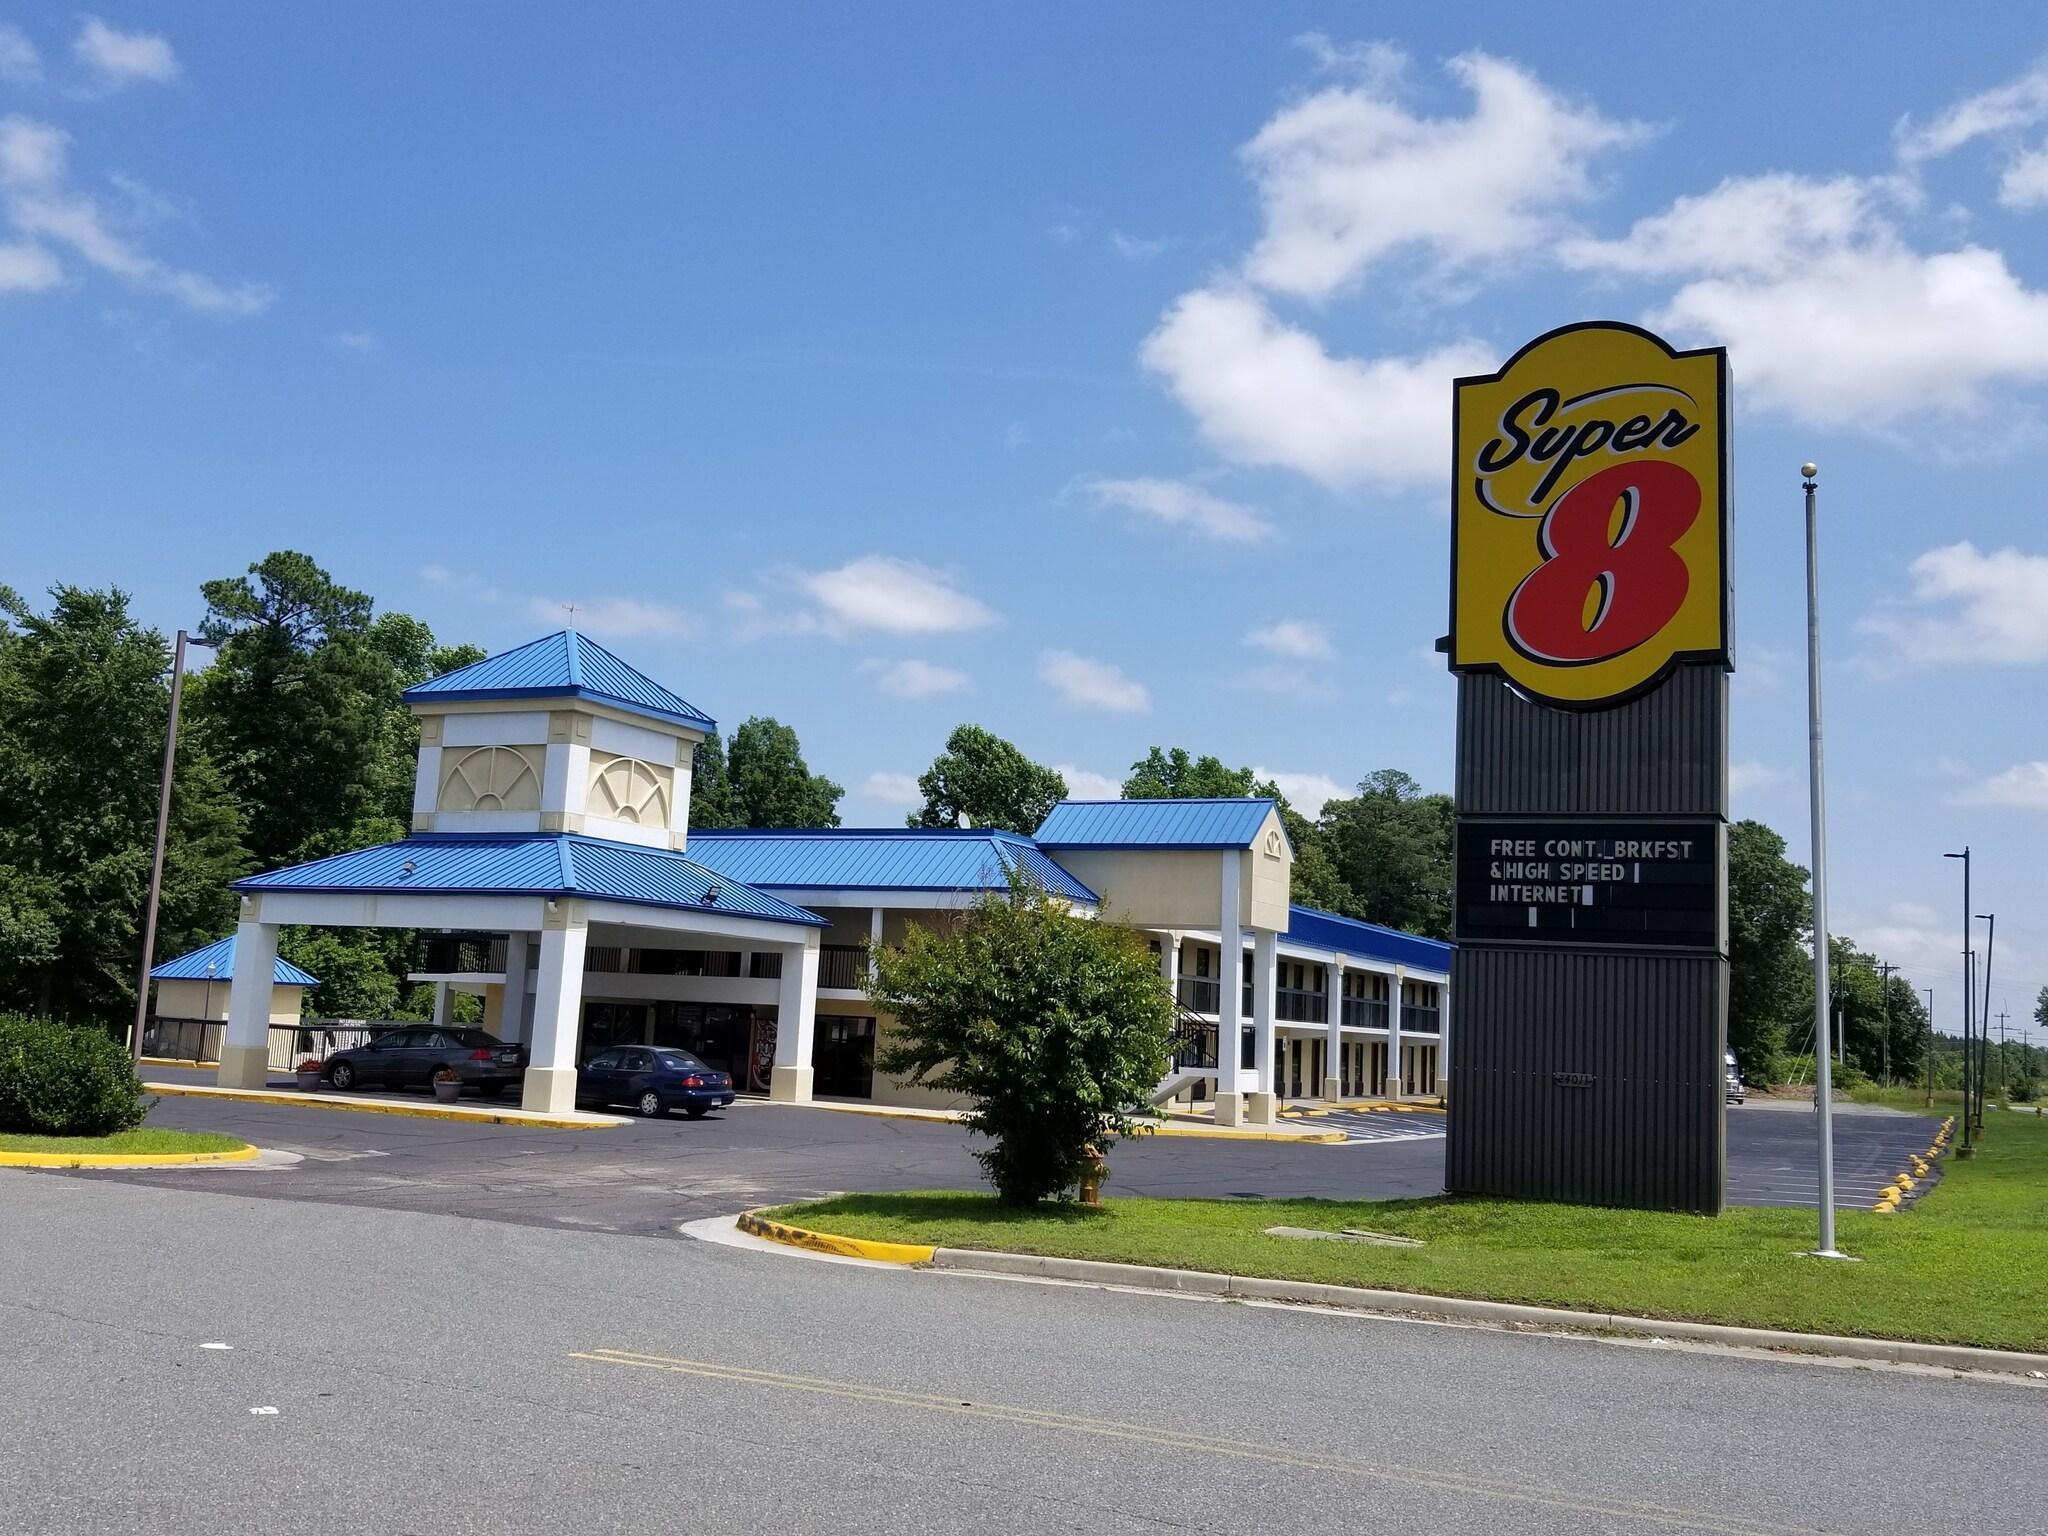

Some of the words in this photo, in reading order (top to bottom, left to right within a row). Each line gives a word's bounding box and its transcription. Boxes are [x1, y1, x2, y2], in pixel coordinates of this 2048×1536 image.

[1474, 386, 1701, 506] Super
[1502, 459, 1702, 668] 8
[1490, 839, 1536, 857] FREE
[1615, 840, 1693, 859] BRKFST
[1560, 863, 1625, 881] SPEED
[1490, 884, 1581, 903] INTERNET
